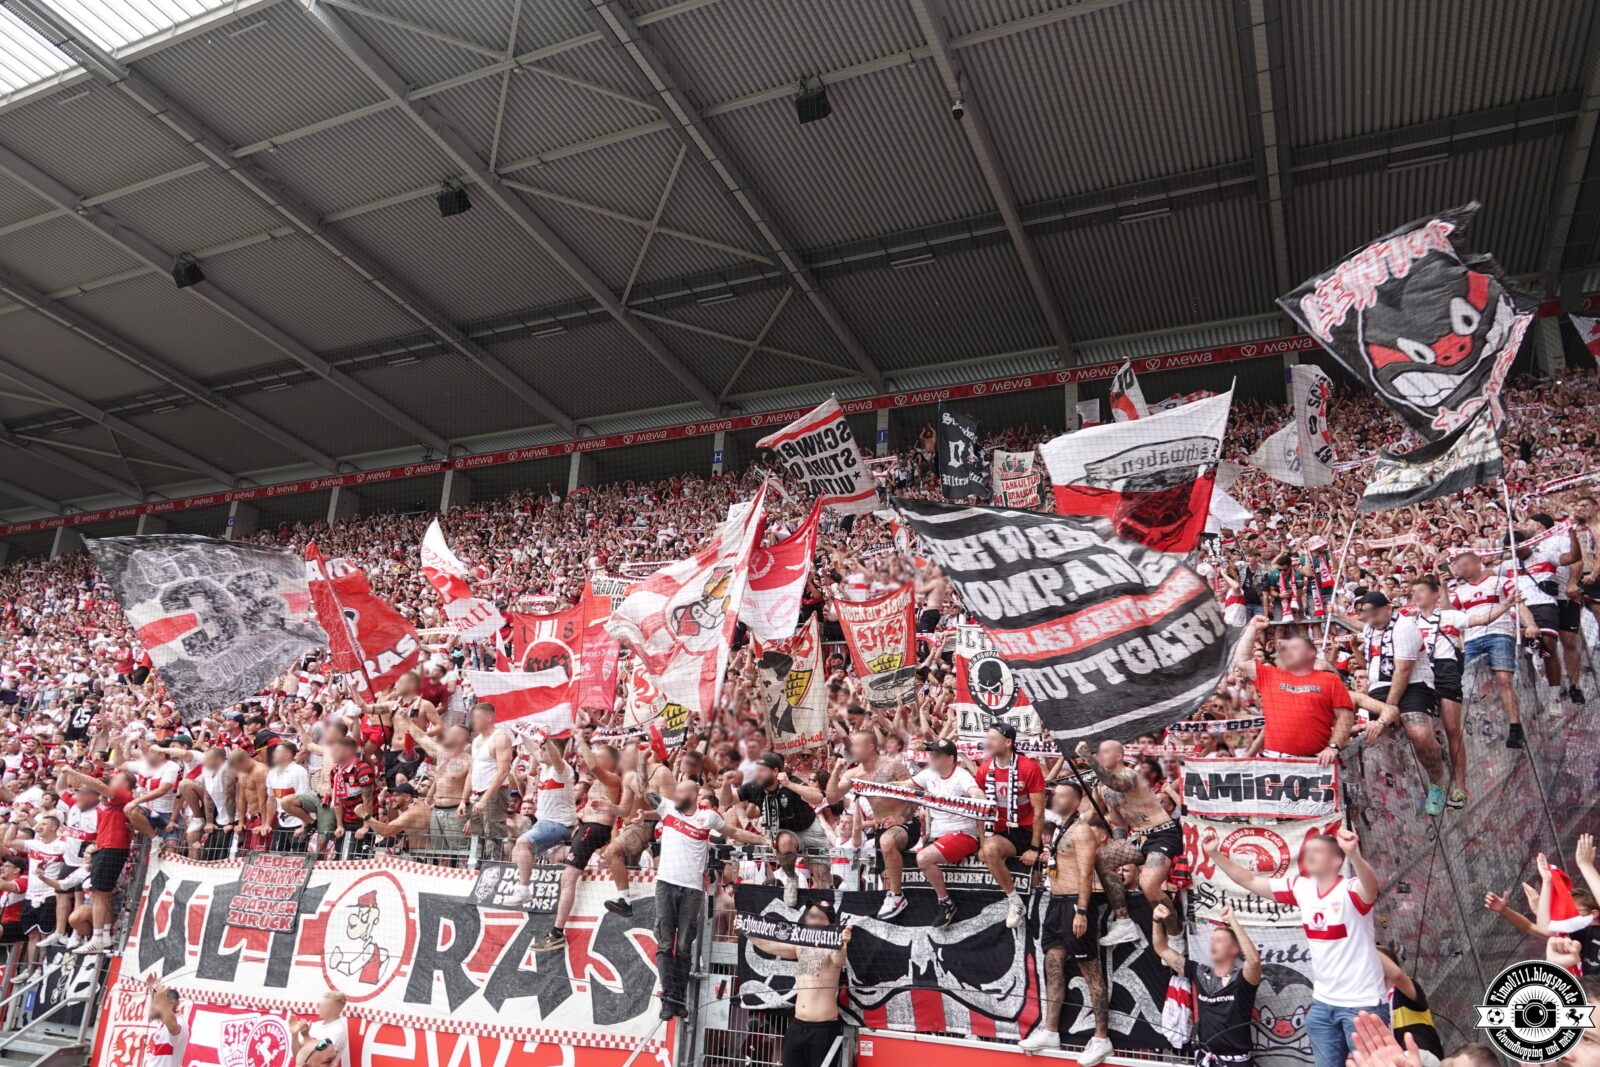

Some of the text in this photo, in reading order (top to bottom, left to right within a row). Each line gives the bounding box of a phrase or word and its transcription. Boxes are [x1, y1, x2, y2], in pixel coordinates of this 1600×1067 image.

[254, 854, 306, 869] JEDER
[241, 864, 309, 886] VERBANNTE
[901, 871, 1029, 890] VERSRBENEN ULAS
[241, 881, 297, 900] KEHRT
[1196, 881, 1302, 923] Stuttga
[227, 909, 294, 931] ZURÜCK
[735, 914, 843, 948] Schwaben Kompanie
